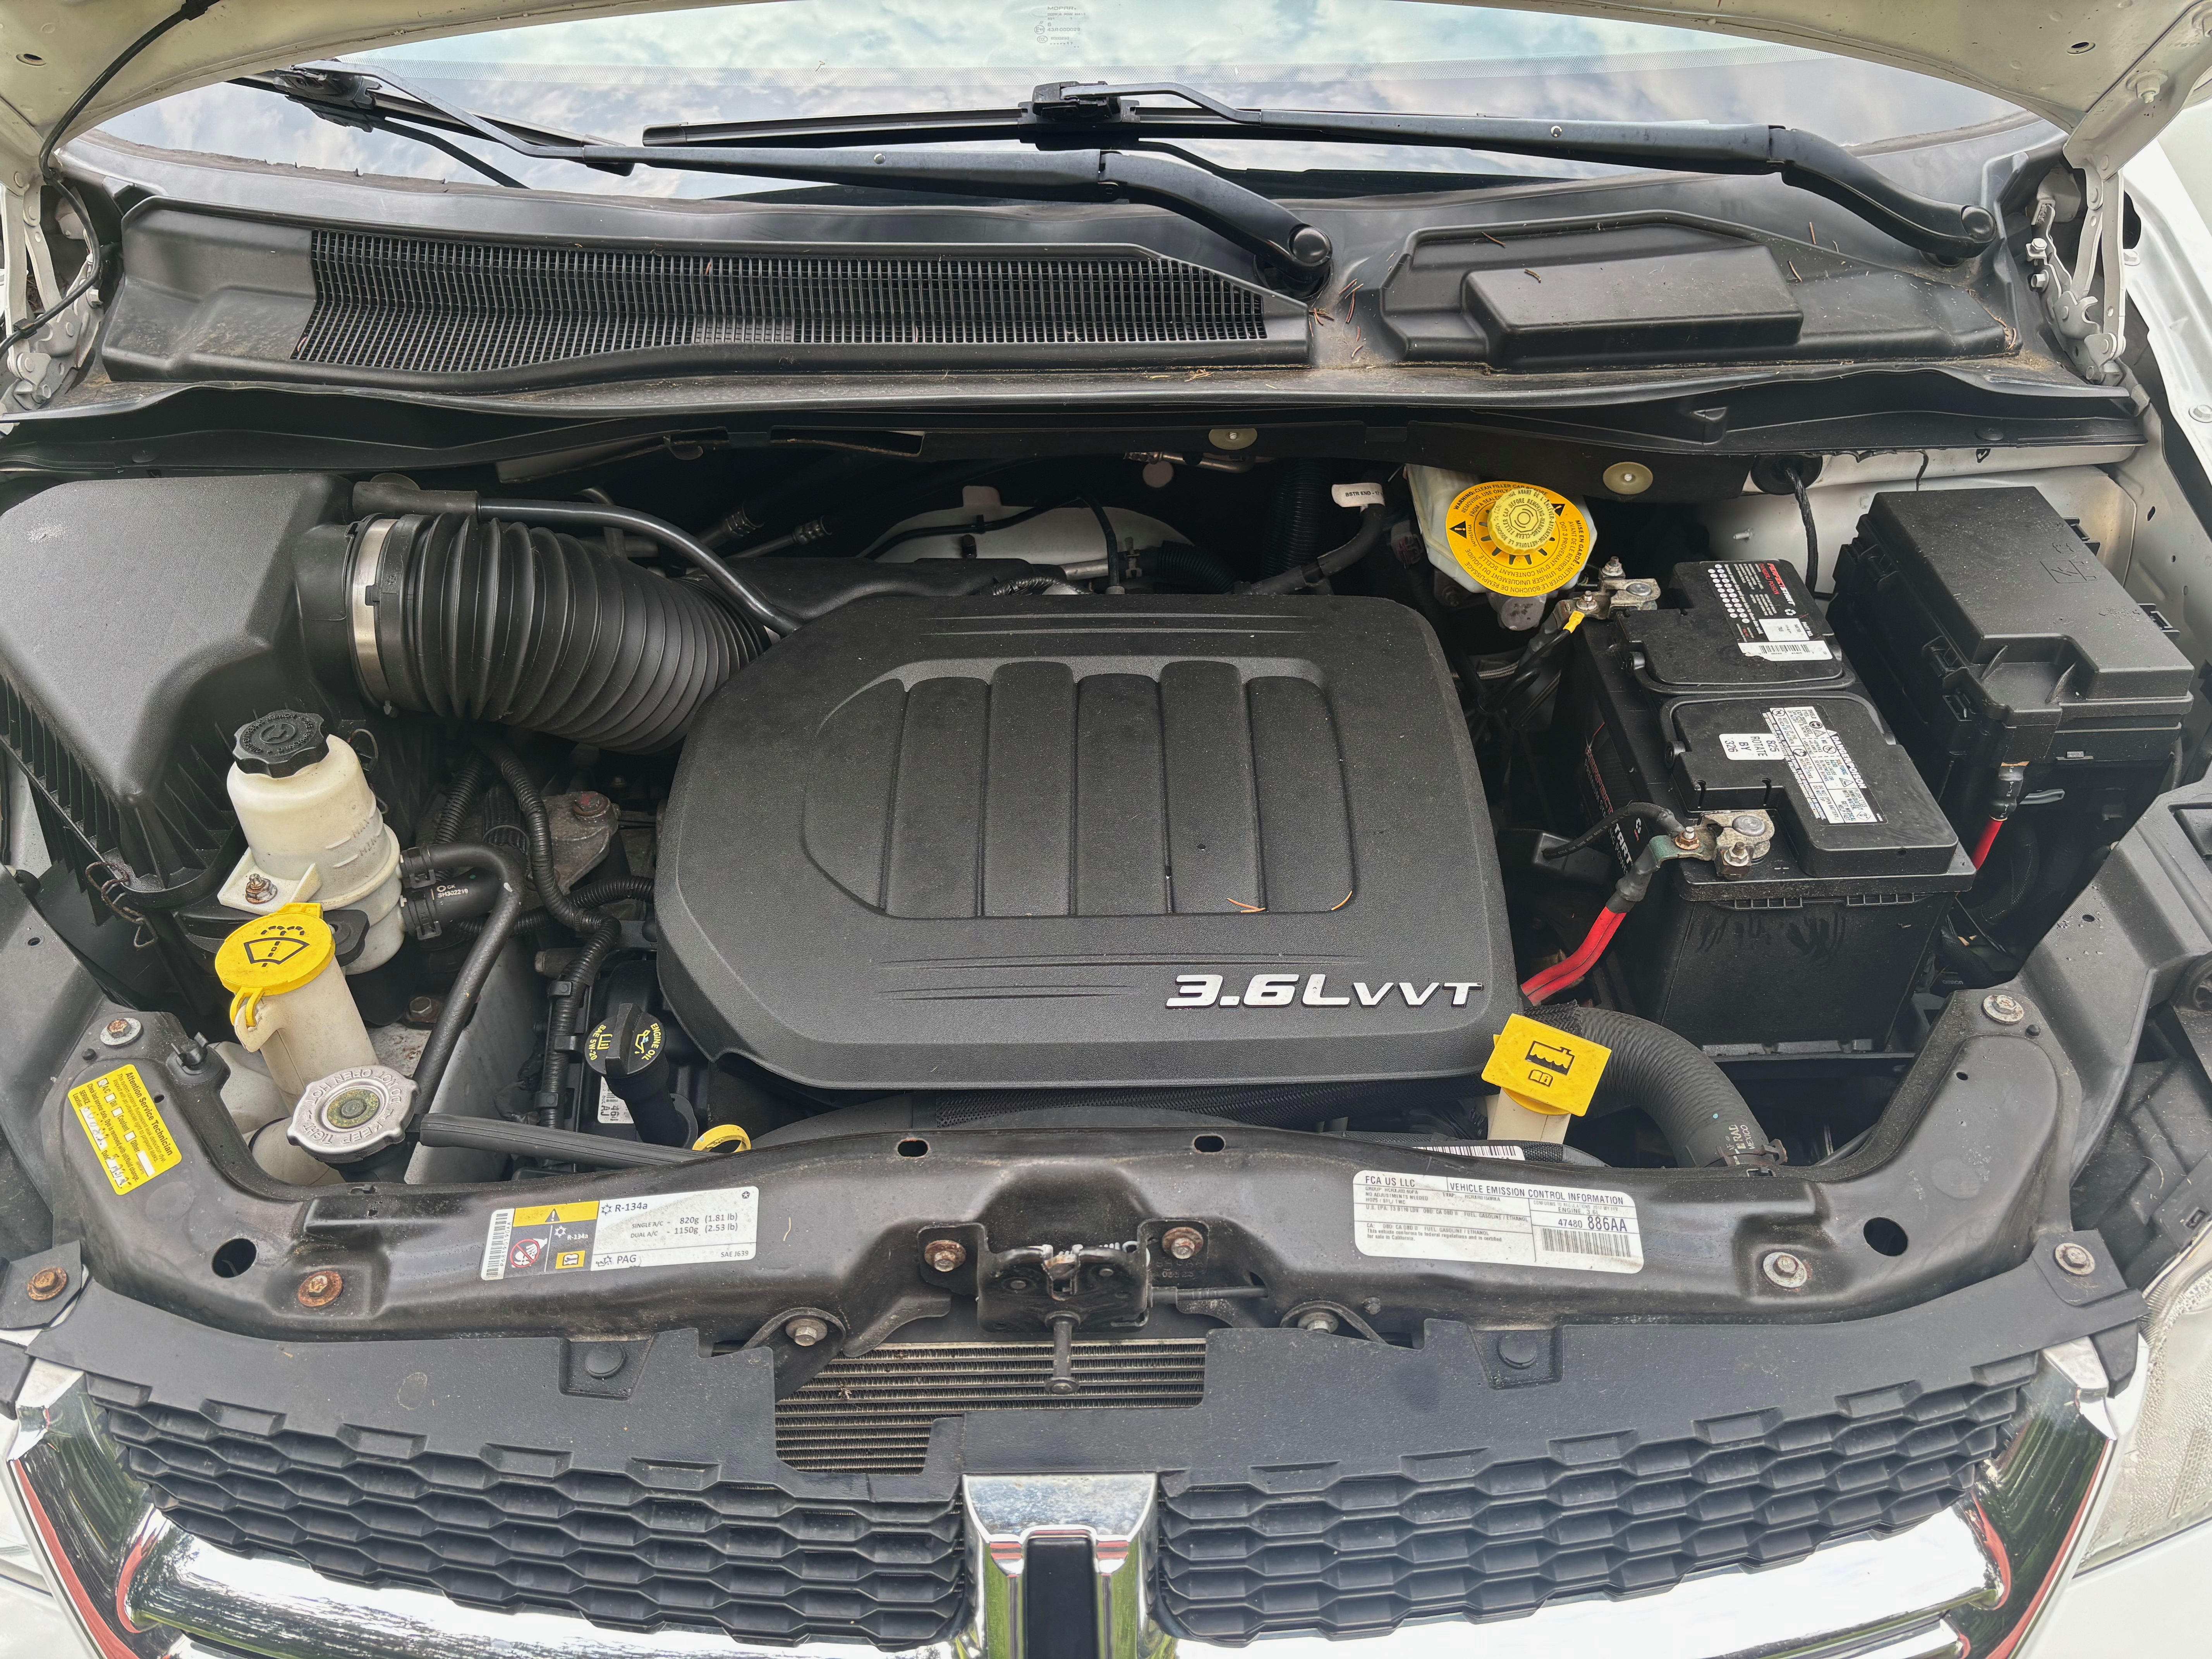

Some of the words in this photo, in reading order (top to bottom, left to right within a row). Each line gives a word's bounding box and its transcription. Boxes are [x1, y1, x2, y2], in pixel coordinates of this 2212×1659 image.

[1469, 505, 1480, 517] FROM
[1503, 519, 1515, 535] FILLER
[1510, 498, 1525, 508] BEFORE
[1568, 521, 1577, 537] AVANT
[1575, 520, 1584, 534] MISE
[1465, 549, 1483, 568] LIQUIDE
[1551, 538, 1568, 567] PROVENANT
[1464, 562, 1500, 588] REMPLISSAGE
[1499, 568, 1535, 577] CONTENANT
[1532, 570, 1556, 584] UTILISER
[1536, 564, 1551, 574] D'UN
[1549, 565, 1573, 586] NETTOYER
[1491, 573, 1530, 586] UNIQUEMENT
[1801, 622, 1810, 630] PART
[1724, 740, 1738, 752] 326
[1738, 742, 1752, 751] BY
[1750, 736, 1768, 757] ROTATE
[1766, 740, 1780, 752] 825
[1831, 737, 1867, 788] DANGER/POISON
[1835, 759, 1848, 775] SULFURIC
[1848, 790, 1863, 809] IMMEDIATELY
[1853, 789, 1862, 799] FLUSH
[1845, 808, 1856, 821] MEDICAL
[2000, 803, 2009, 817] FL-4
[1166, 974, 1350, 1008] 3.6L
[1353, 982, 1484, 1009] VVT
[592, 1024, 606, 1038] SAE
[650, 1023, 662, 1049] ENGINE
[589, 1039, 598, 1061] 5W-20
[641, 1049, 656, 1061] OIL
[334, 1068, 373, 1085] OPEN
[374, 1071, 398, 1089] NOT
[79, 1090, 90, 1104] SERVICE
[102, 1085, 110, 1093] A/C
[307, 1082, 332, 1104] HOT
[390, 1088, 402, 1104] DO
[72, 1093, 82, 1108] Location
[112, 1079, 123, 1092] Inspect
[125, 1103, 137, 1121] ultraviolet
[133, 1121, 142, 1131] light
[140, 1134, 152, 1151] pinpoint
[120, 1081, 130, 1093] system
[127, 1092, 137, 1108] contains
[134, 1107, 148, 1127] fluorescent
[149, 1135, 161, 1154] detection
[125, 1072, 144, 1097] Attention
[139, 1097, 156, 1120] Service
[151, 1120, 174, 1155] Technician
[86, 1084, 96, 1094] Check
[94, 1099, 104, 1111] service
[103, 1119, 112, 1128] Dye
[110, 1130, 122, 1146] removed
[118, 1145, 126, 1154] with
[122, 1152, 133, 1168] oil/fluid
[118, 1115, 129, 1131] Coolant
[302, 1123, 333, 1144] TIGHT
[341, 1121, 383, 1144] KEEP
[1740, 1124, 1755, 1149] MEXICO
[130, 1139, 141, 1152] Other
[1365, 1175, 1381, 1185] FCA
[1385, 1177, 1396, 1186] US
[1400, 1178, 1415, 1187] LLC
[1450, 1183, 1483, 1193] VEHICLE
[1486, 1186, 1525, 1197] EMISSION
[1528, 1189, 1565, 1200] CONTROL
[1568, 1192, 1623, 1204] INFORMATION
[615, 1202, 648, 1212] R-134a
[680, 1216, 699, 1226] 820g
[704, 1214, 725, 1223] (1.81
[727, 1212, 738, 1221] lb)
[1558, 1218, 1583, 1228] 47480
[1587, 1216, 1628, 1232] 886AA
[674, 1226, 698, 1236] 1150g
[704, 1223, 726, 1233] (2.53
[727, 1222, 738, 1231] lb)
[617, 1254, 637, 1264] PAG
